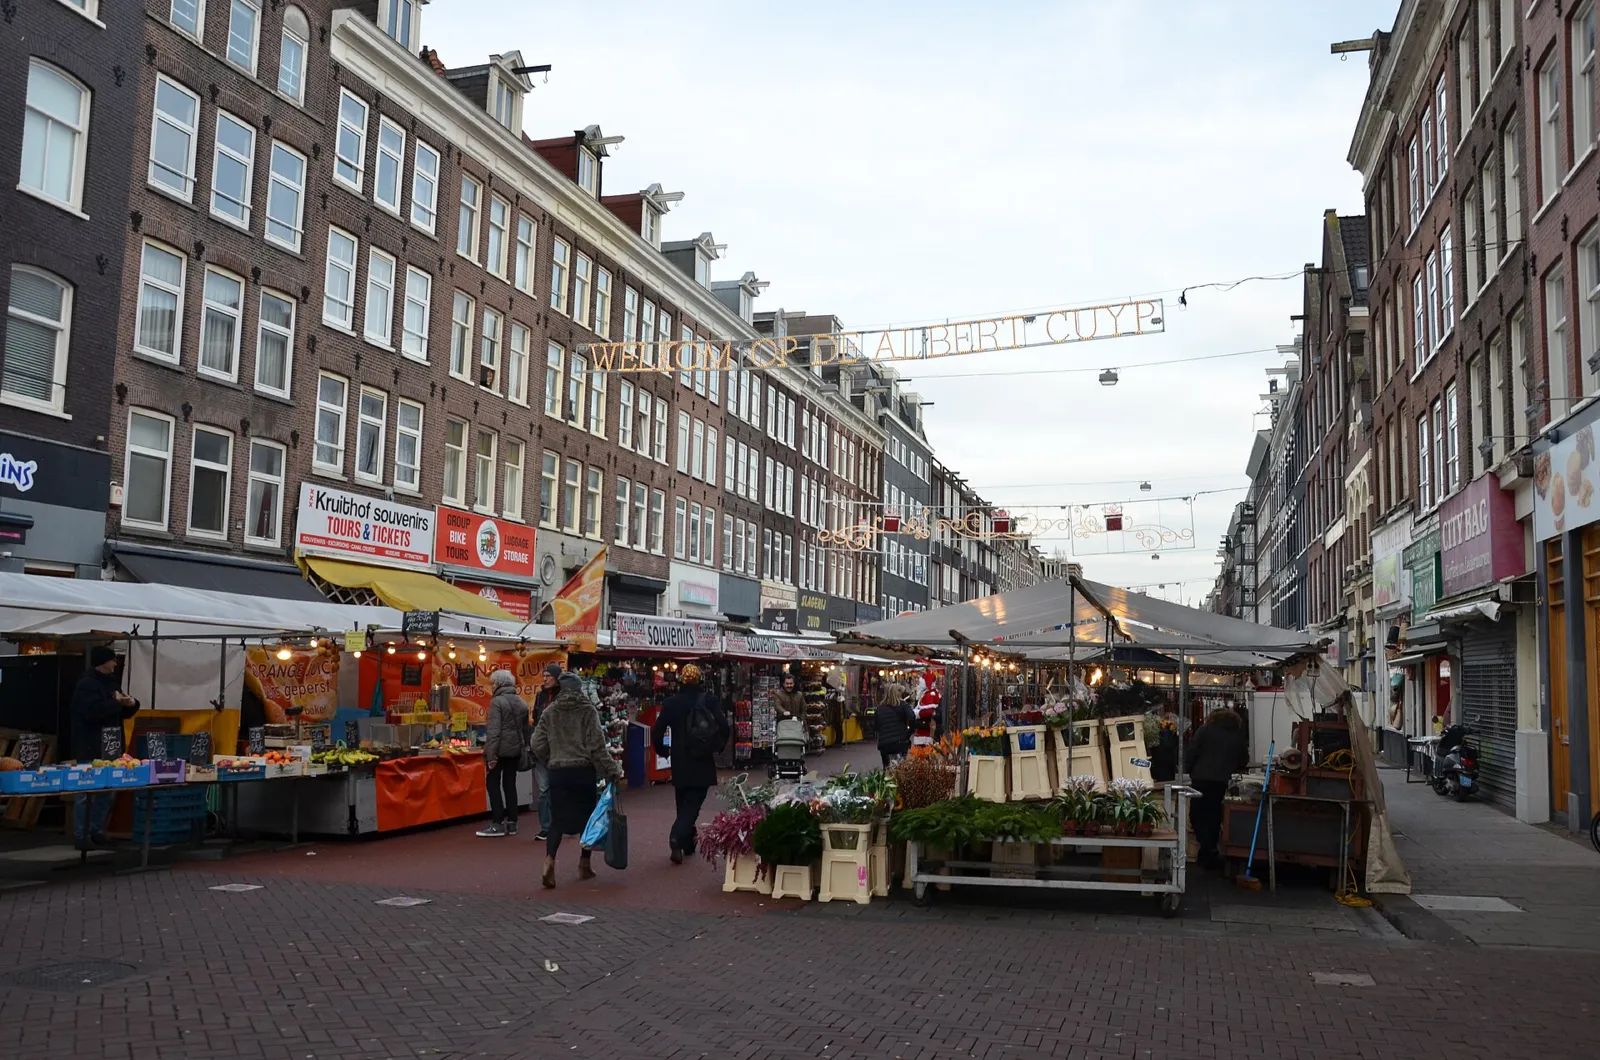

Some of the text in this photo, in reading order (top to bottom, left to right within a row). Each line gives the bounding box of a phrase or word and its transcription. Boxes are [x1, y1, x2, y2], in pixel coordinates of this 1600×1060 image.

[588, 300, 1155, 372] WELKOM OP DE ALBERT CUYP
[315, 490, 429, 531] Kruithof souvenirs
[447, 513, 471, 529] GROUP
[1442, 513, 1464, 552] CITY
[1464, 498, 1489, 542] BAG
[327, 516, 411, 547] TOURS & TICKETS
[449, 530, 467, 545] BIKE
[302, 535, 326, 545] SOUVENIRS
[504, 534, 529, 549] LUGGAGE
[446, 545, 469, 561] TOURS
[503, 549, 529, 564] STORAGE
[801, 594, 827, 611] SLAGERIJ
[771, 621, 782, 630] Pho
[648, 621, 695, 647] souvenirs
[284, 679, 330, 701] geperst
[451, 684, 486, 697] vers
